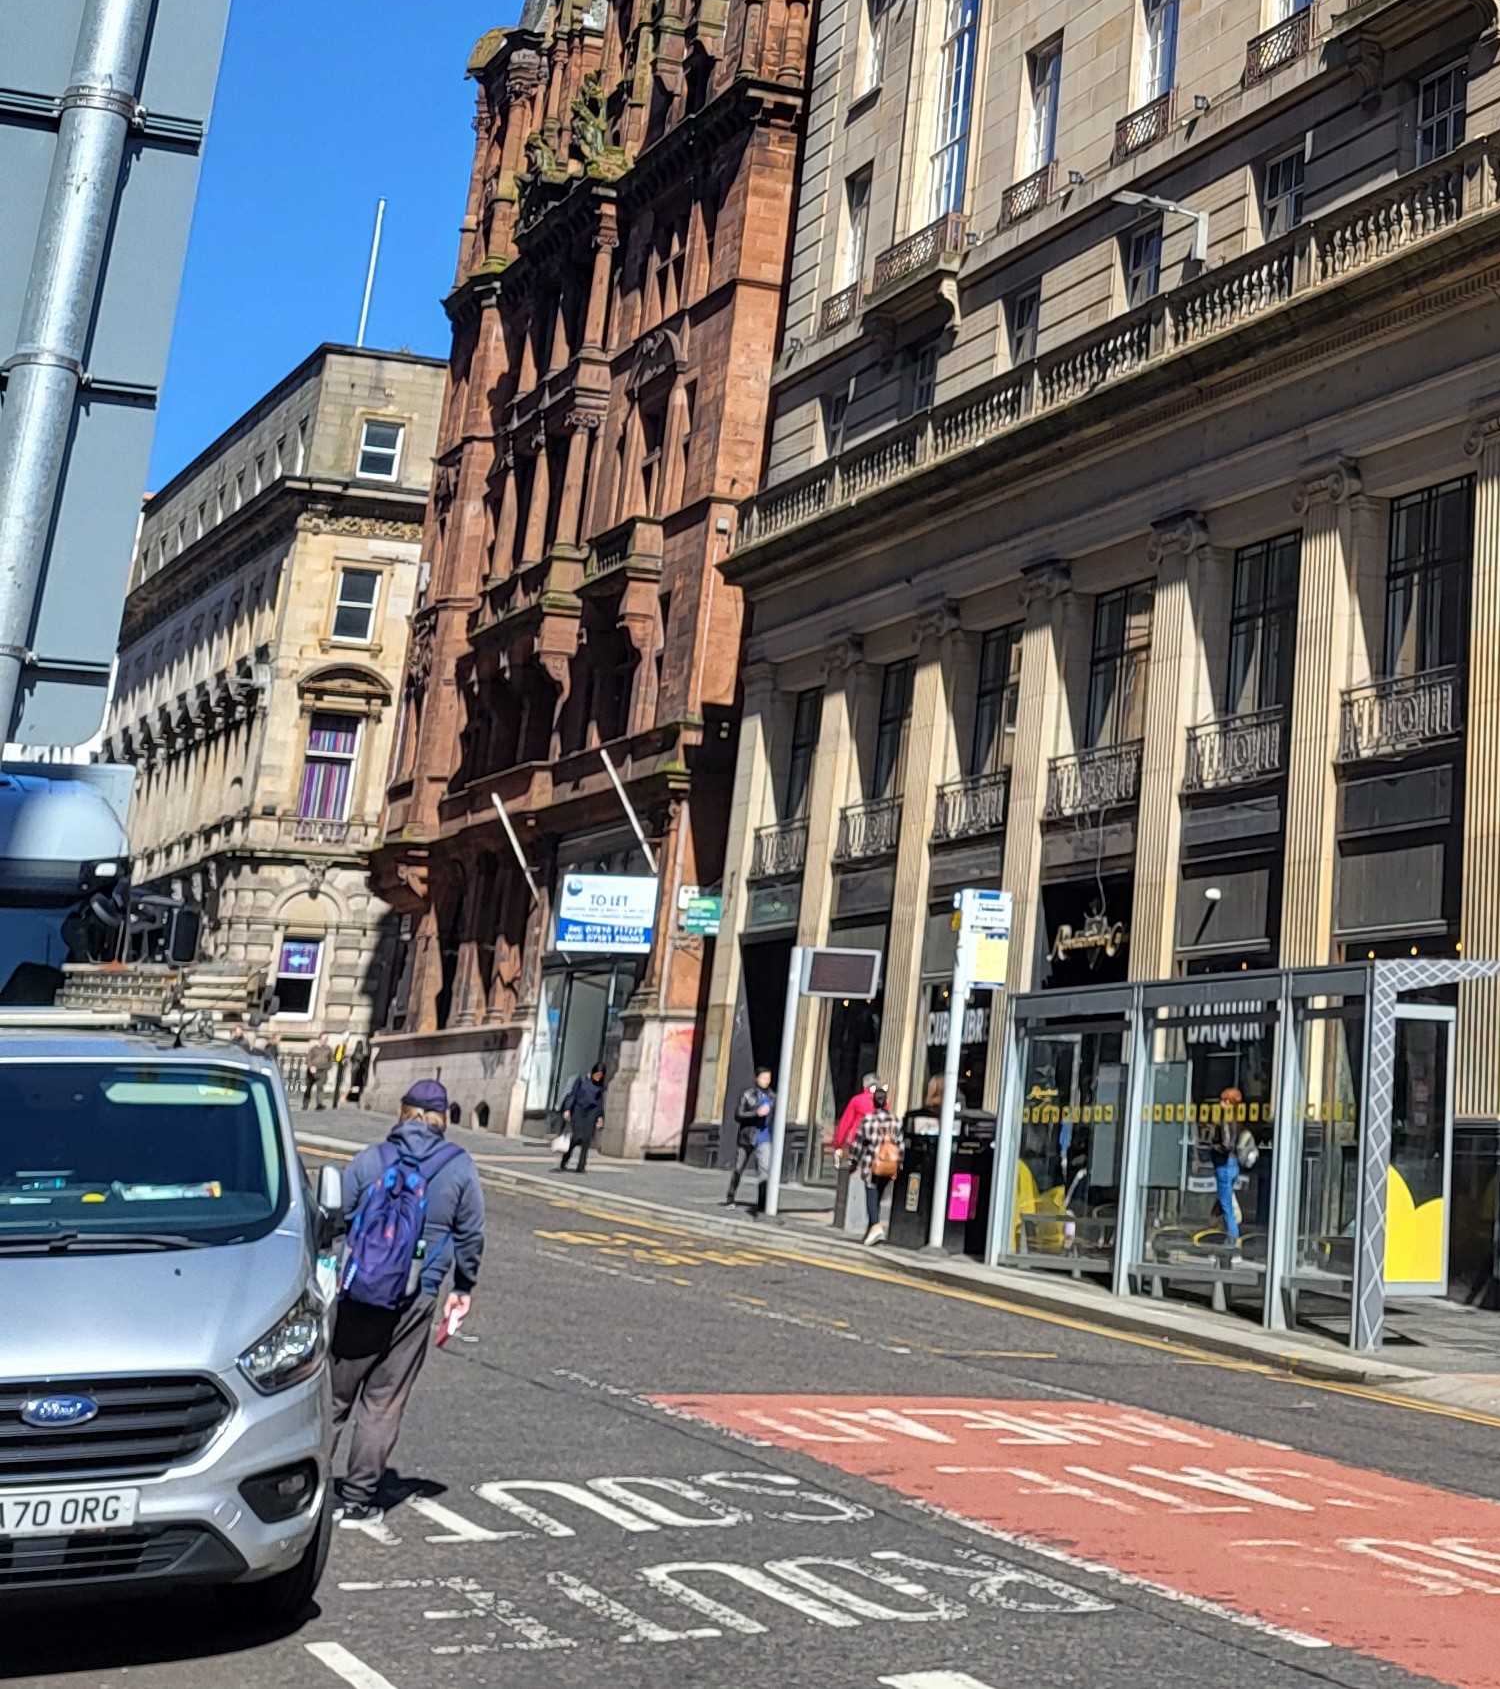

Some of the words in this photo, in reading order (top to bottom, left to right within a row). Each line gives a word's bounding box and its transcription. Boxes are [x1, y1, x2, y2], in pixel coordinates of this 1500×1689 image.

[590, 894, 607, 906] TO
[610, 895, 629, 907] LET
[960, 1007, 991, 1044] IBRE
[0, 1500, 51, 1529] 70
[60, 1495, 121, 1525] ORG
[337, 1547, 1117, 1654] ROUTE
